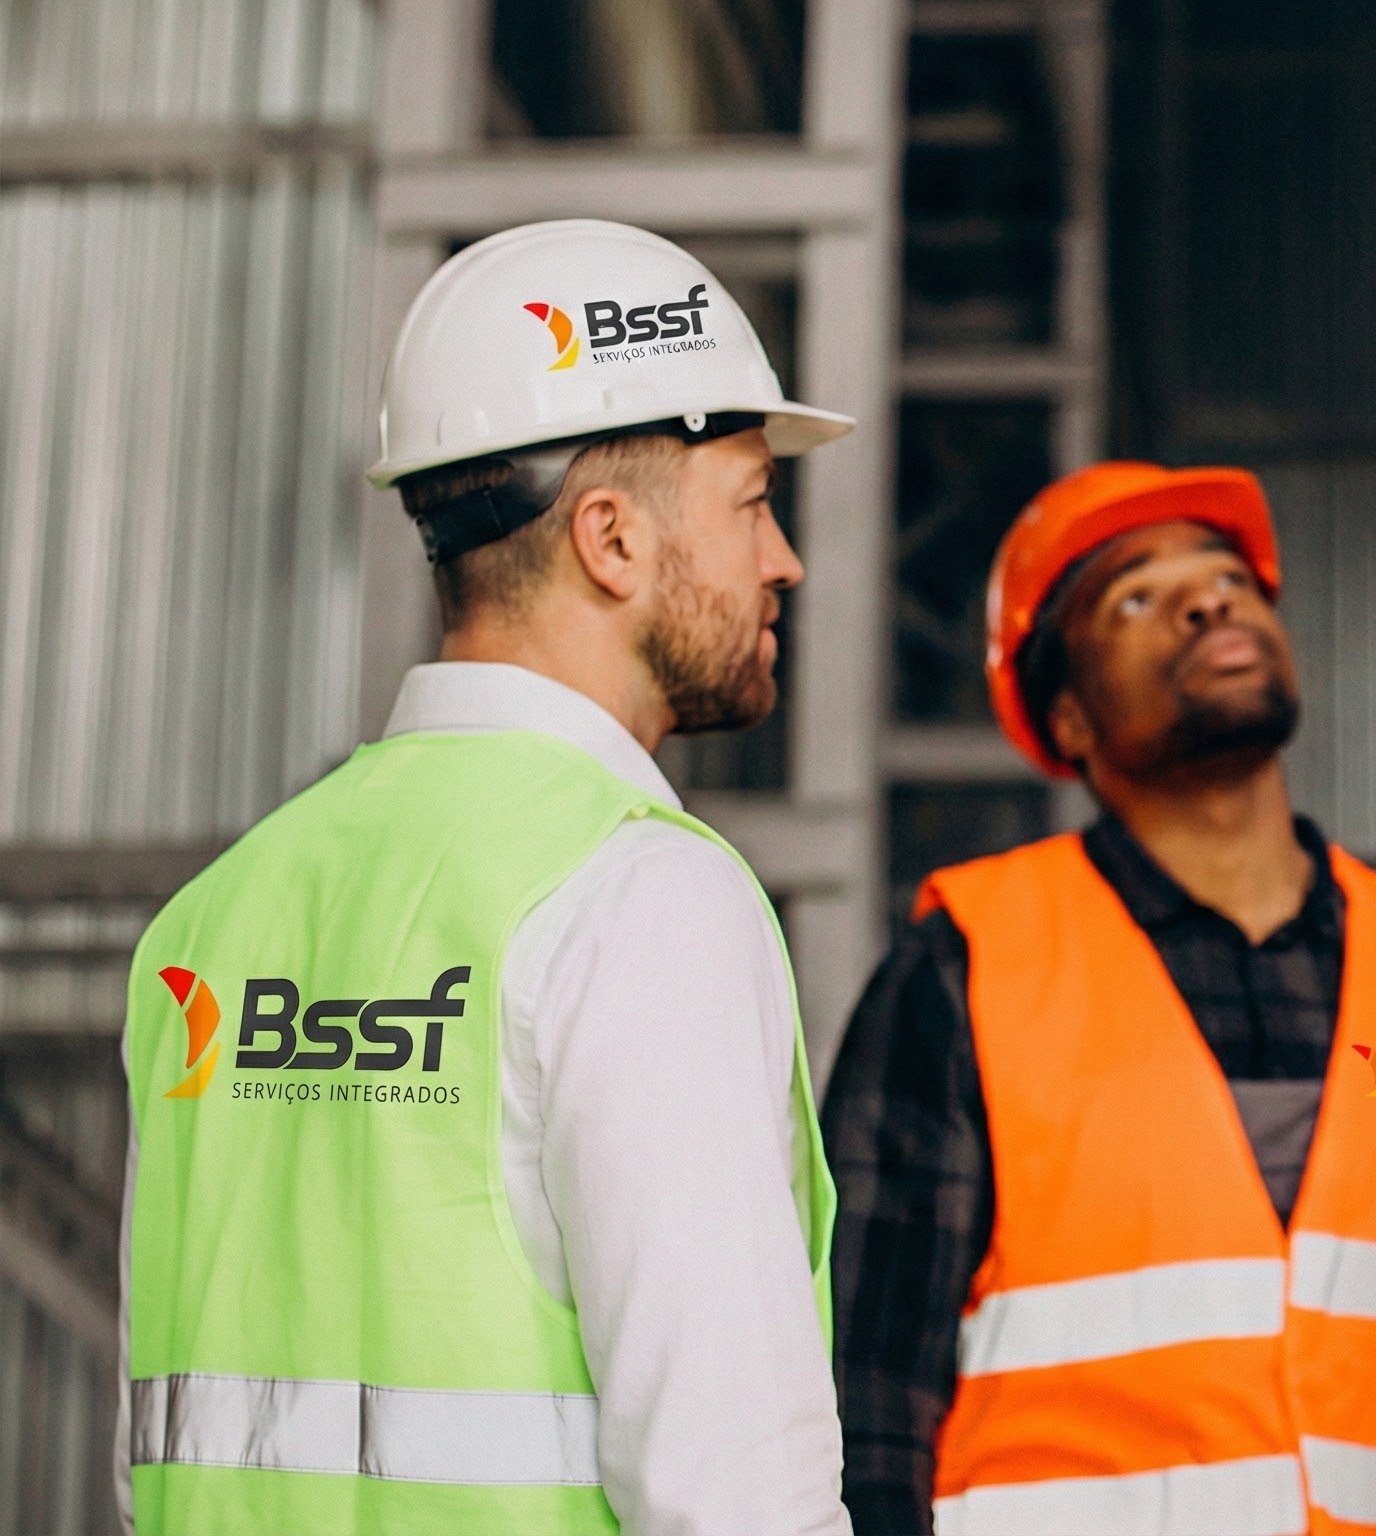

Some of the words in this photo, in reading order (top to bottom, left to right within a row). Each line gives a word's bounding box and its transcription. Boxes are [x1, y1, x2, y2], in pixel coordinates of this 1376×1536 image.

[584, 283, 709, 349] Bssf
[235, 965, 472, 1072] Bssf
[231, 1082, 321, 1105] SERVIÇOS
[329, 1084, 461, 1105] INTEGRADOS
